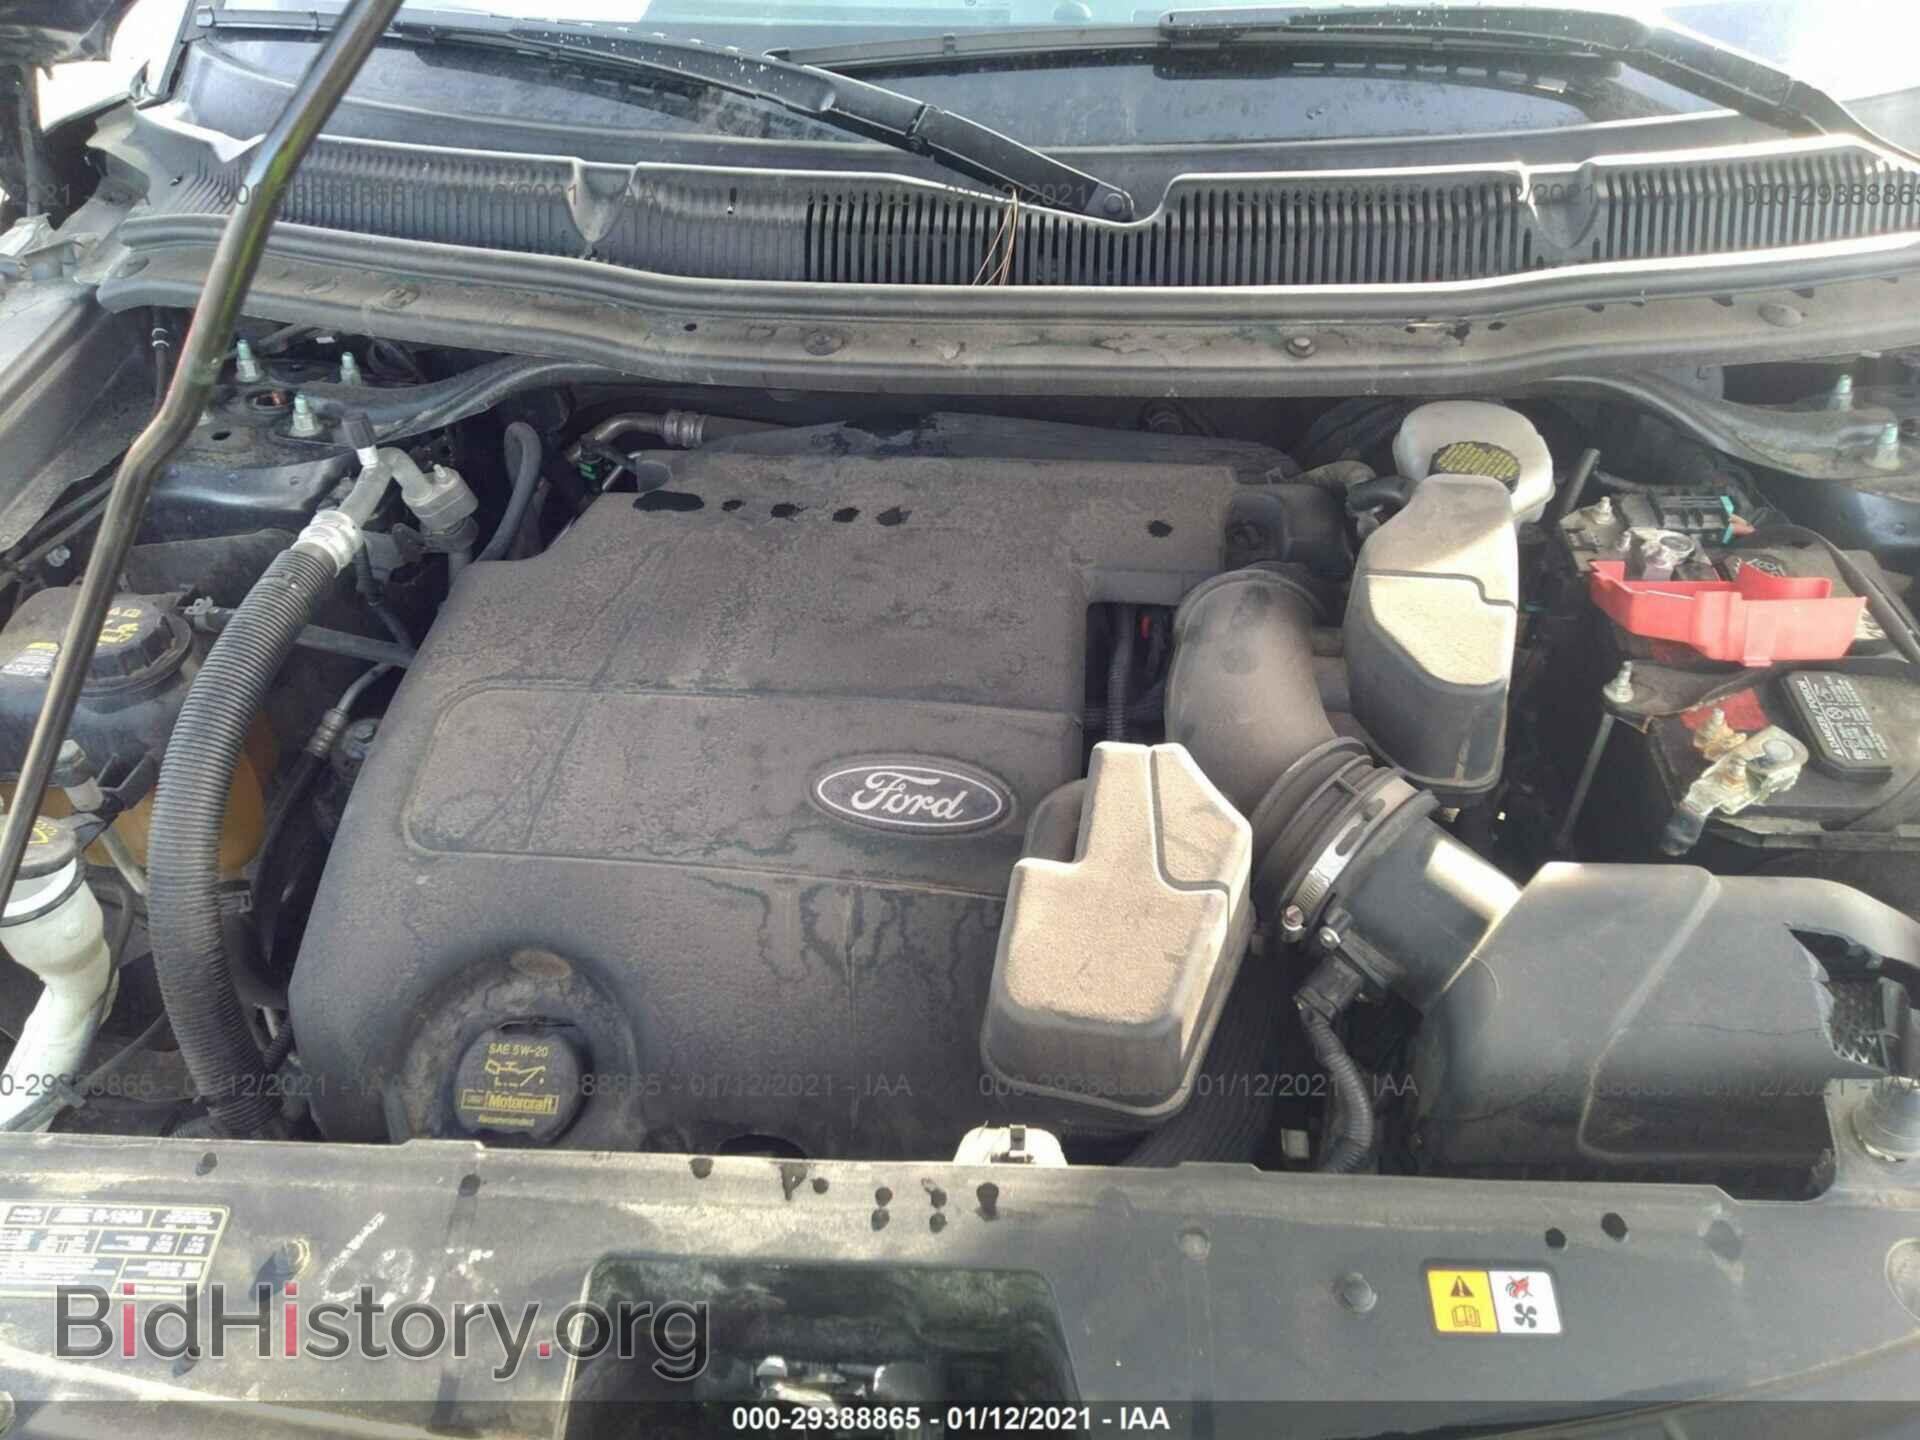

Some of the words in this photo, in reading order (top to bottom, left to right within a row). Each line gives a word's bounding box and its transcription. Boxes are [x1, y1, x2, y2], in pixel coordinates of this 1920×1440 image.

[851, 771, 968, 819] Ford
[488, 1043, 510, 1055] SAE
[512, 1044, 548, 1057] 5W-20
[488, 1094, 553, 1111] Motorcraft
